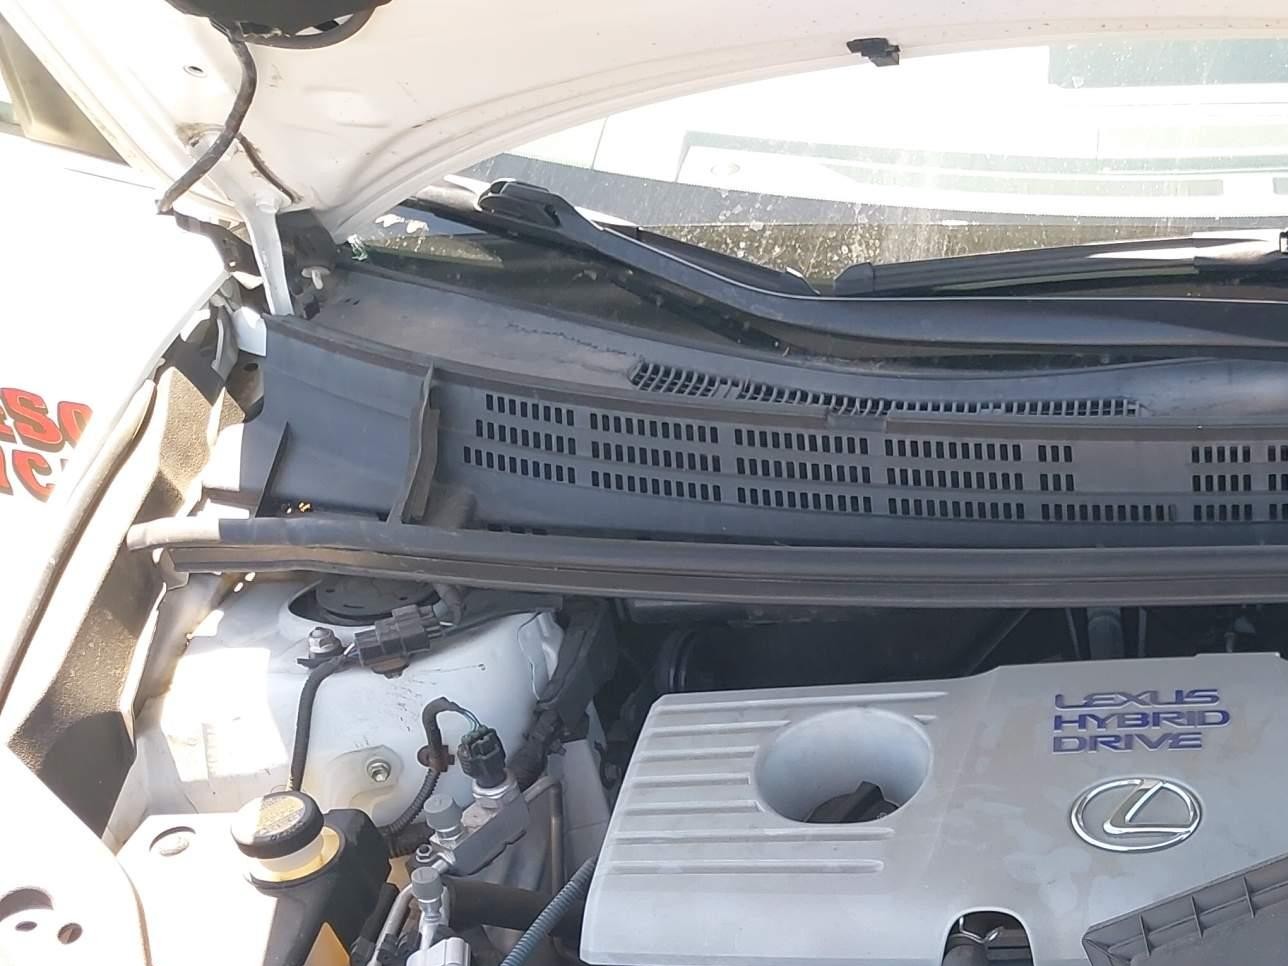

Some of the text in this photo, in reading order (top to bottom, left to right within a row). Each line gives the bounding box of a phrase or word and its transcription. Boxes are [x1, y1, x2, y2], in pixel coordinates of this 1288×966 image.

[1054, 689, 1220, 709] LEXUS
[1053, 710, 1230, 731] HYBRID
[1052, 732, 1202, 753] DRIVE
